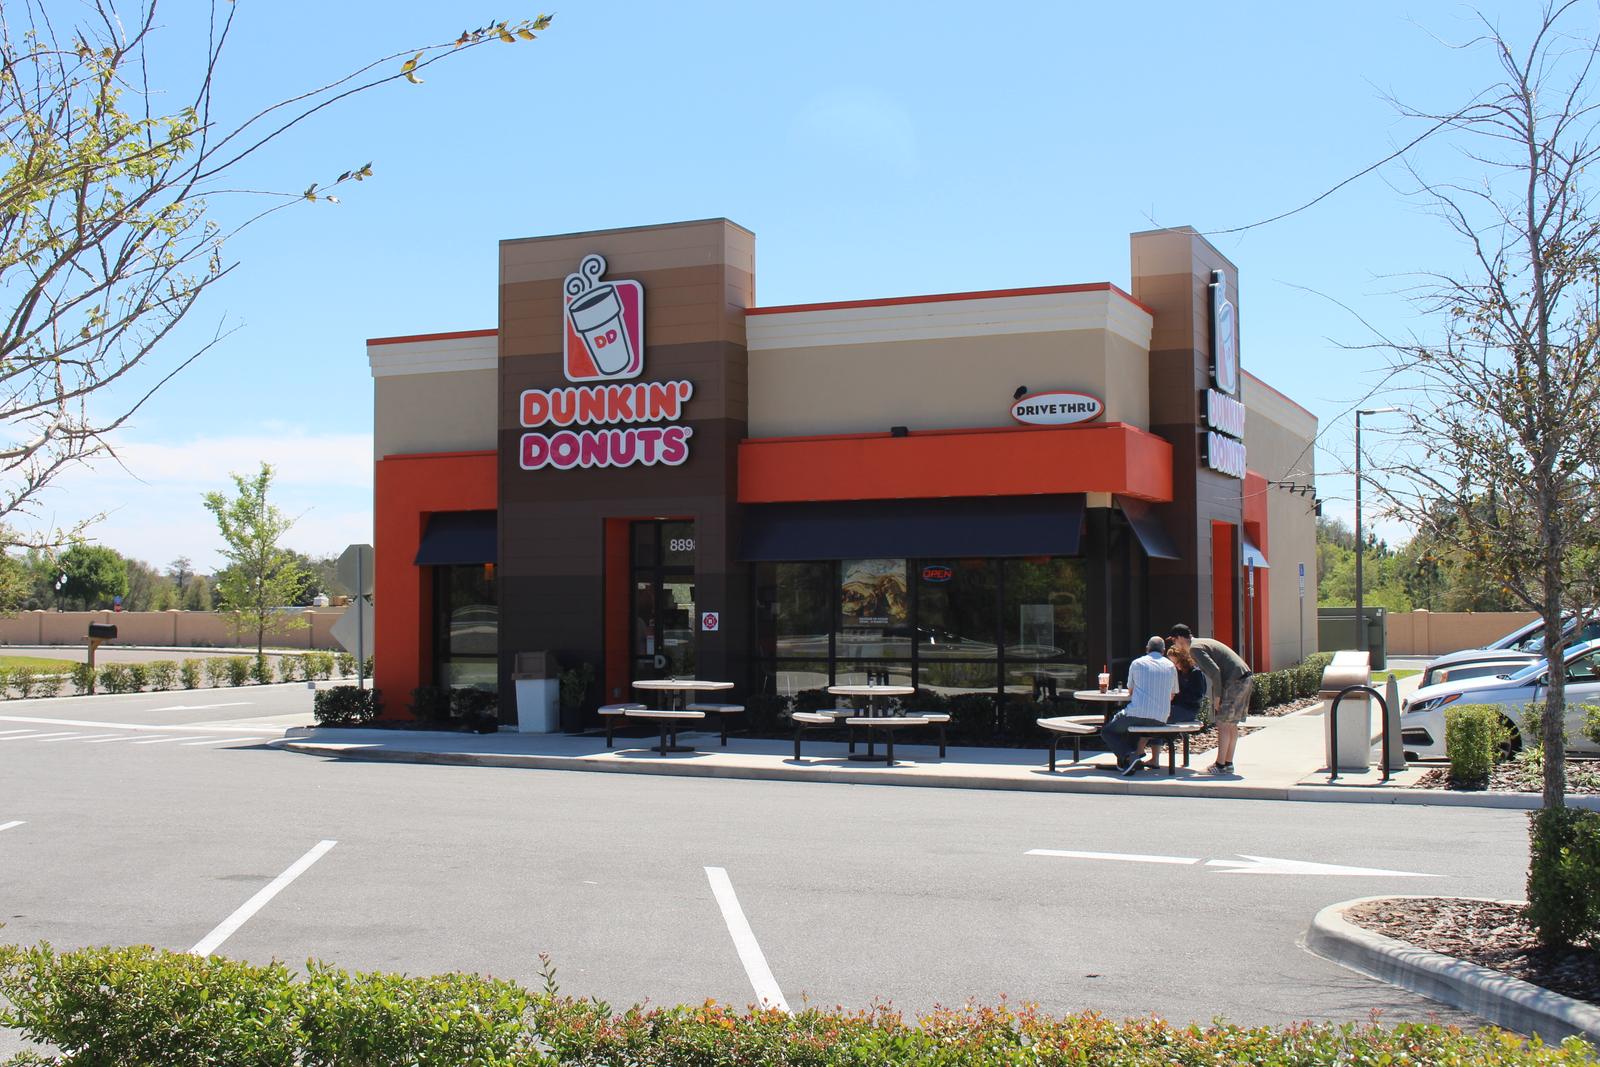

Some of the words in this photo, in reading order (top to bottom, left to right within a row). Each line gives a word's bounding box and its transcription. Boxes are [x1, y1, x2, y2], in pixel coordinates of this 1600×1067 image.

[594, 329, 617, 349] DD
[522, 381, 690, 426] DUNKIN'
[1016, 404, 1057, 416] DRIVE
[1059, 402, 1096, 413] THRU
[922, 569, 952, 579] OPEN
